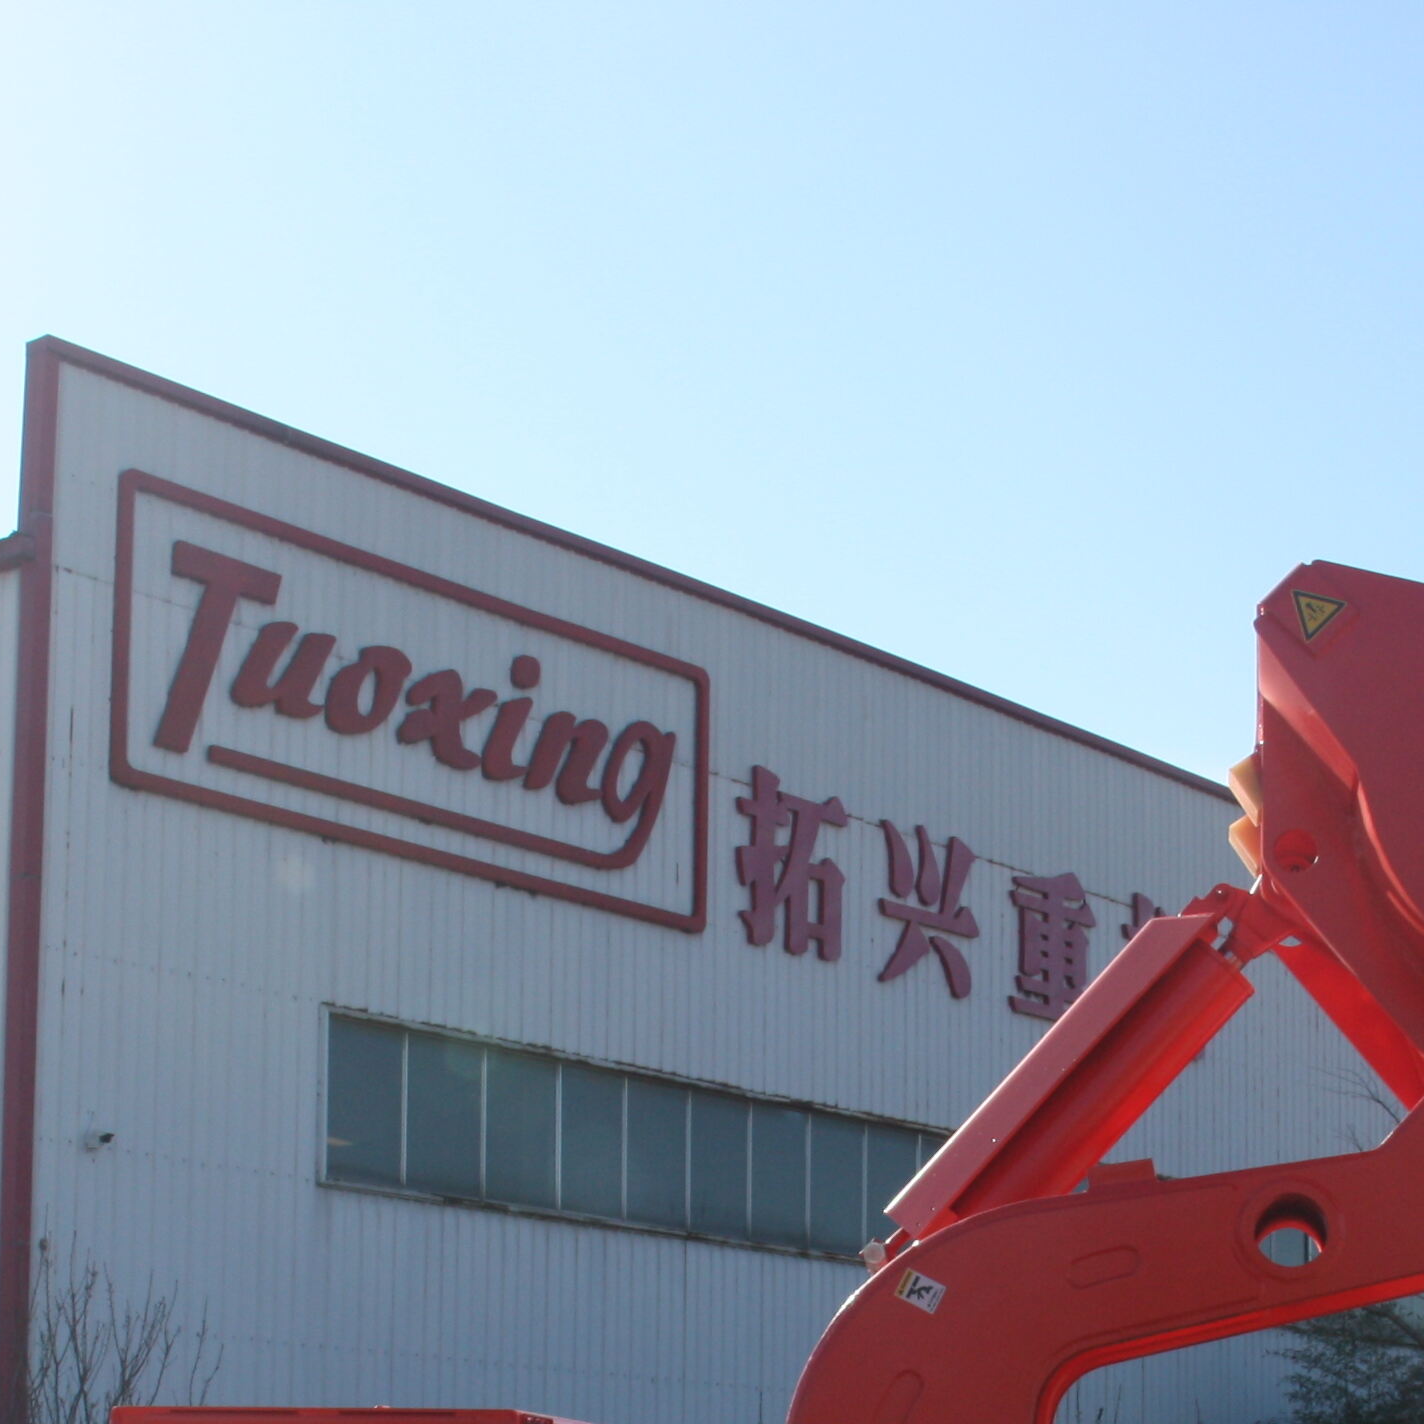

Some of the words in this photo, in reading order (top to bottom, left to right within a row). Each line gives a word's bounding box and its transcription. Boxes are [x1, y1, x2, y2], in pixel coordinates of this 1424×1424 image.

[153, 540, 676, 870] Tuoxing
[735, 765, 1169, 1020] 拓兴重
